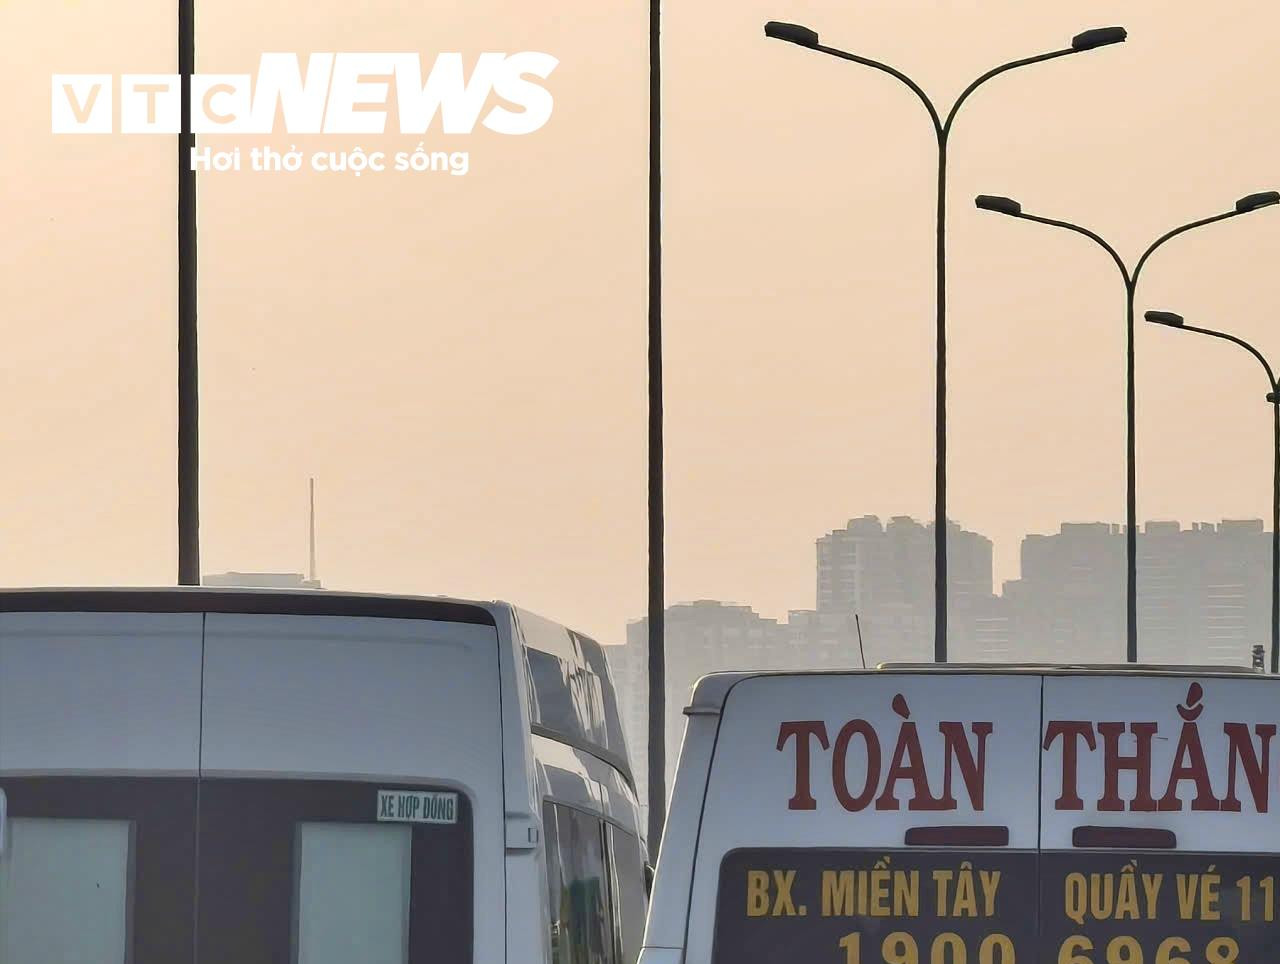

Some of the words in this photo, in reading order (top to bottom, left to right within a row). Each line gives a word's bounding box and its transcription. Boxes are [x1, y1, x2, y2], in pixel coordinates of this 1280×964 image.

[776, 693, 993, 812] TOÀN
[380, 794, 395, 818] XE
[747, 870, 807, 916] BX.
[822, 856, 920, 917] MIỀN
[932, 861, 1001, 917] TÂY
[1065, 859, 1164, 925] QUẦY
[1176, 864, 1221, 921] VÉ
